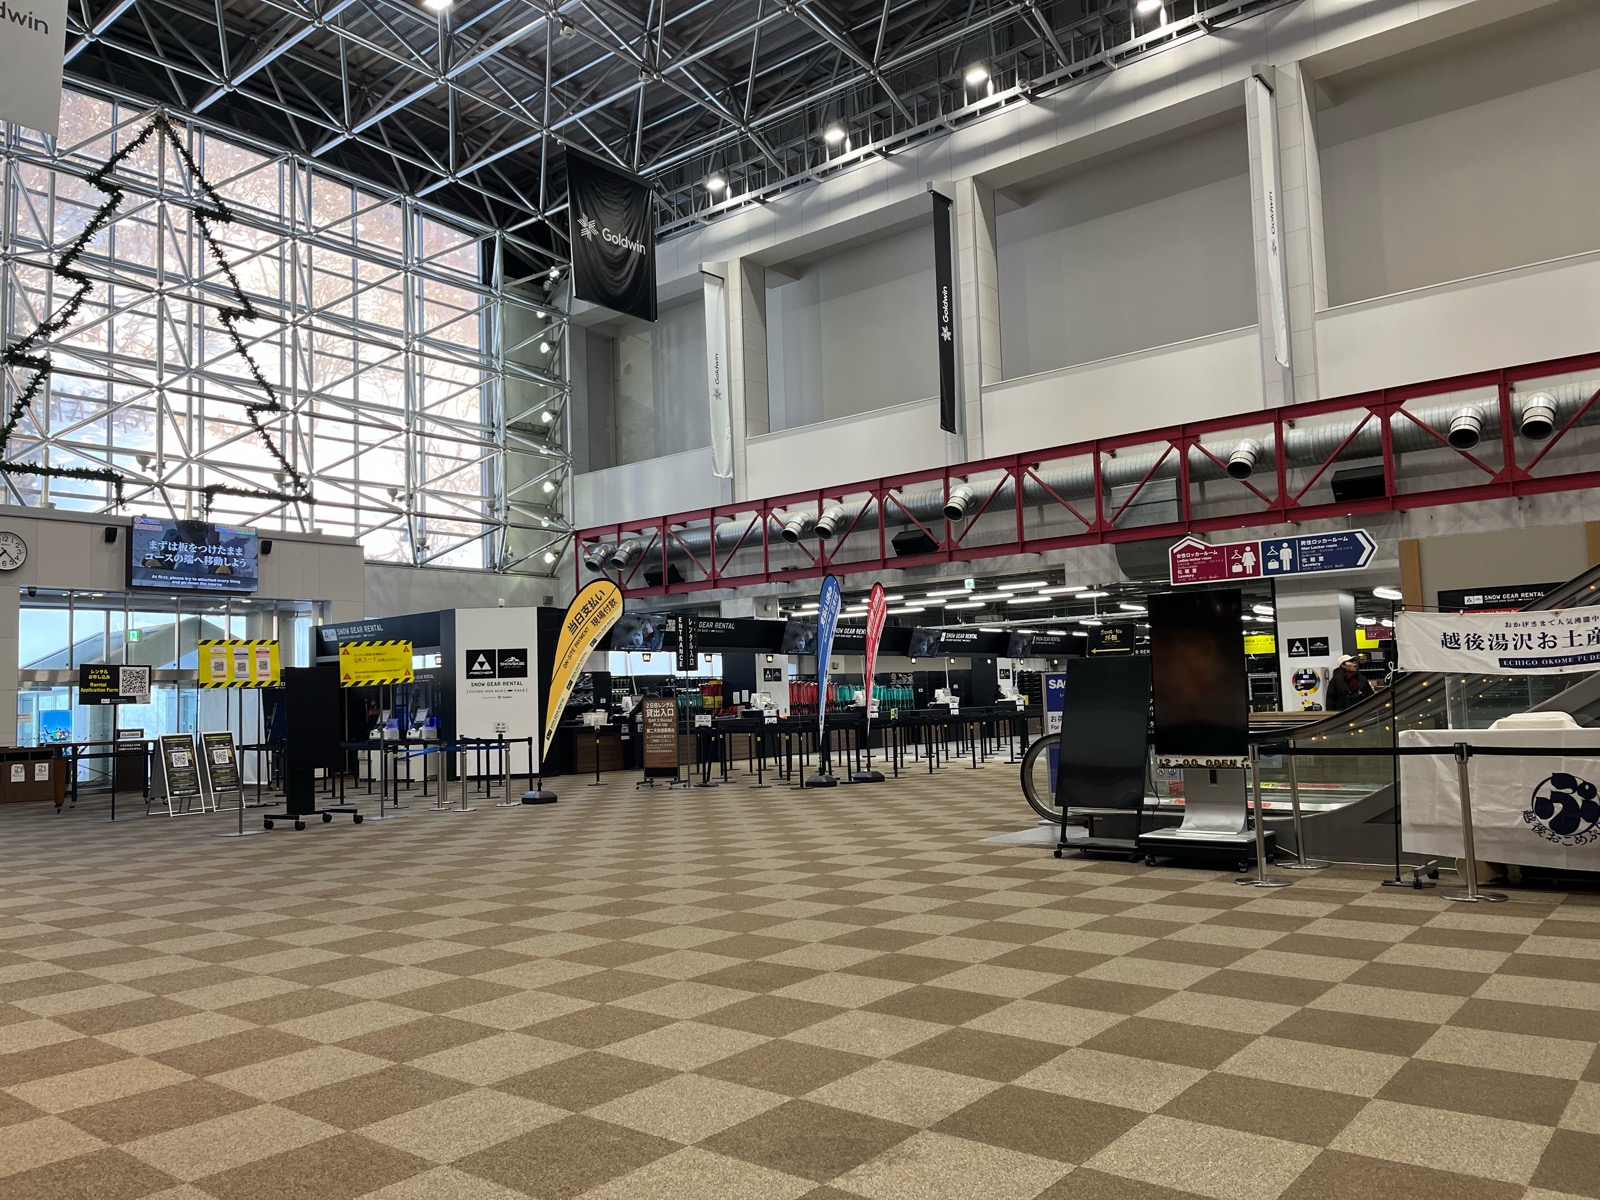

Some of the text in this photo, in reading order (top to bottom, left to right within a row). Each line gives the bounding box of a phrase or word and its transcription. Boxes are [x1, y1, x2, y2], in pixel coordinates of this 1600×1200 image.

[601, 227, 646, 255] Goldwin
[1300, 536, 1349, 546] 男性ロッカールーム
[148, 540, 243, 556] まずは板をつけたまま
[1176, 550, 1218, 559] 女性ロッカールーム
[145, 553, 247, 567] コースの端へ移動しよう
[567, 589, 606, 636] 当日支払い
[590, 597, 618, 628] 現場付款
[336, 624, 383, 636] SNOW GEAR RENTAL
[563, 626, 590, 669] ON-SITE PAYMENT
[1541, 657, 1574, 665] OKOME
[645, 708, 674, 718] 貸出入口
[1206, 759, 1237, 768] OPEN
